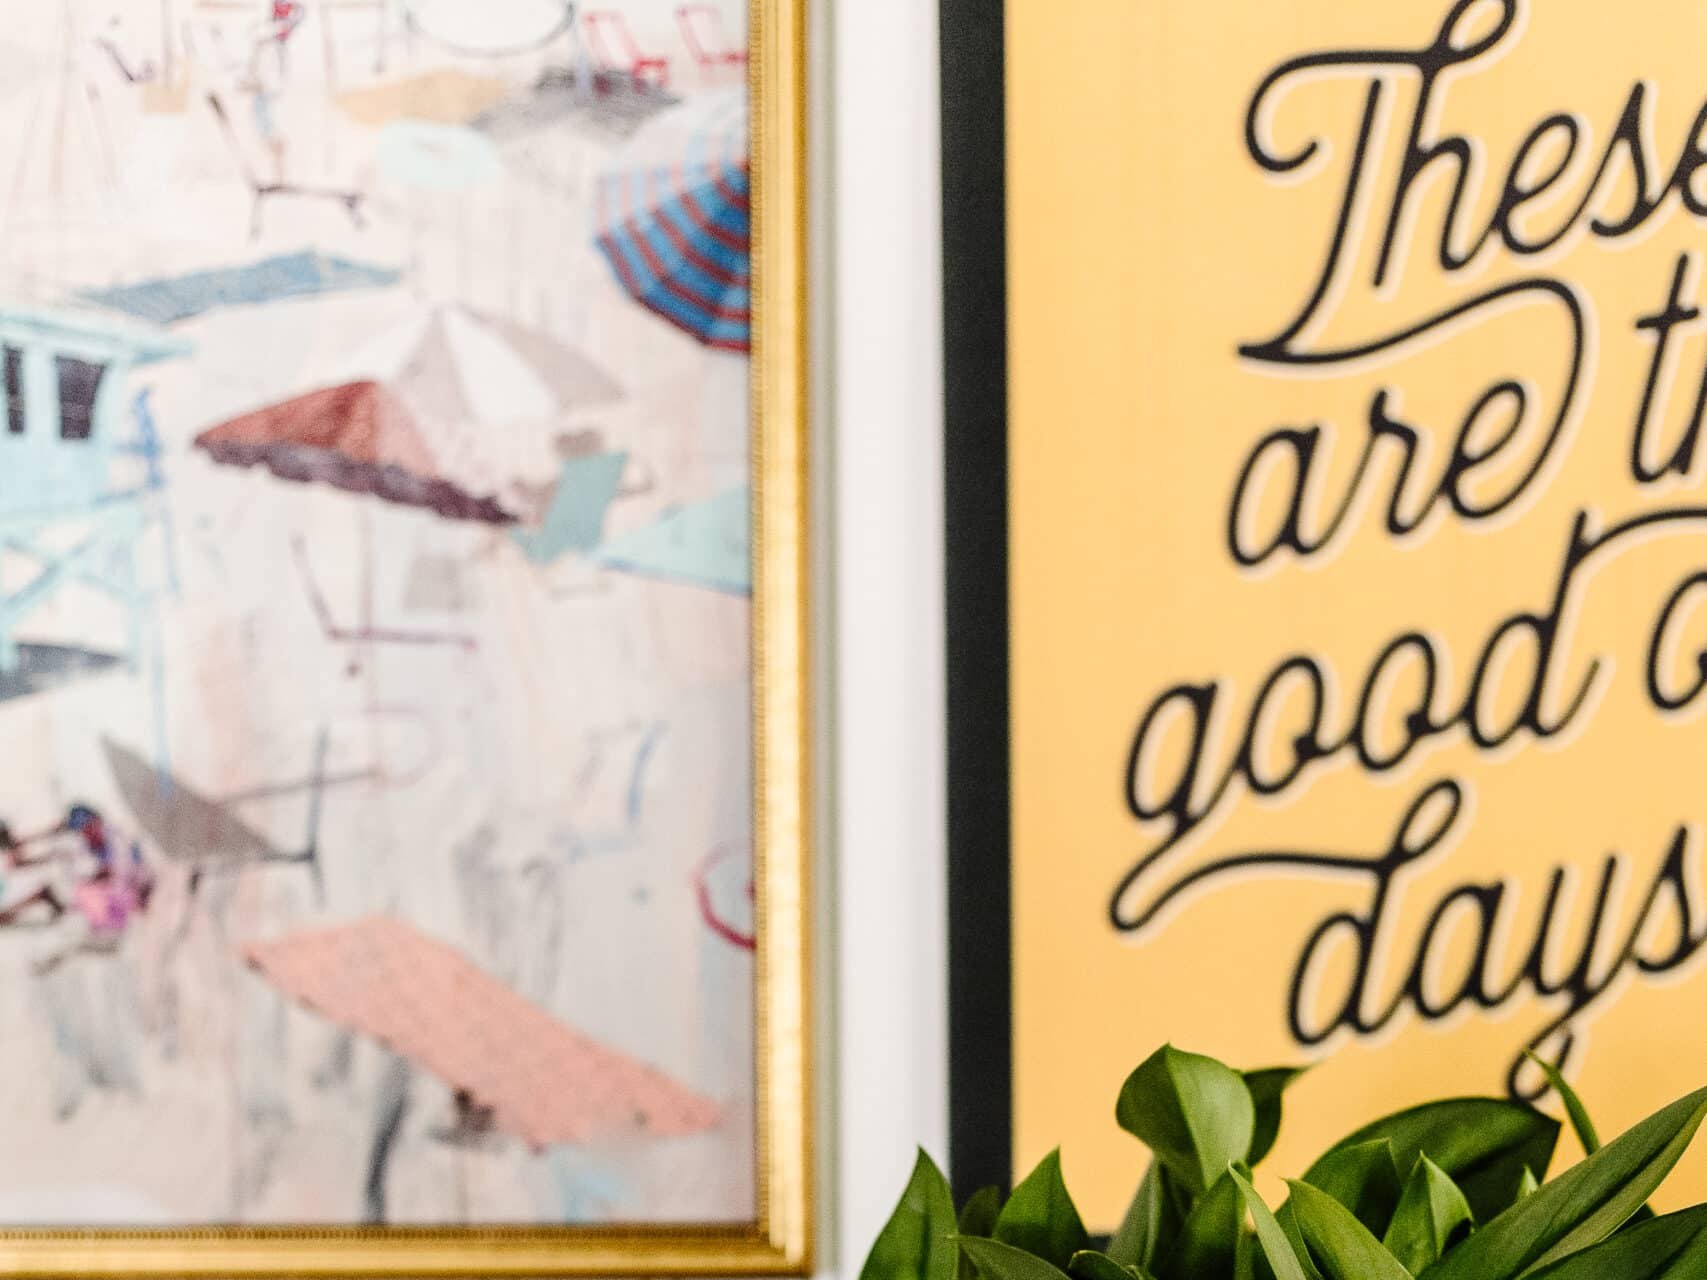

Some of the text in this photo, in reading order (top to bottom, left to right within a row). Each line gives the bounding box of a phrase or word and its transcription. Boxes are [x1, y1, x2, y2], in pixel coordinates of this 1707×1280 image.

[1228, 253, 1707, 566] are t
[1110, 512, 1600, 931] good
[1287, 779, 1707, 1102] days
